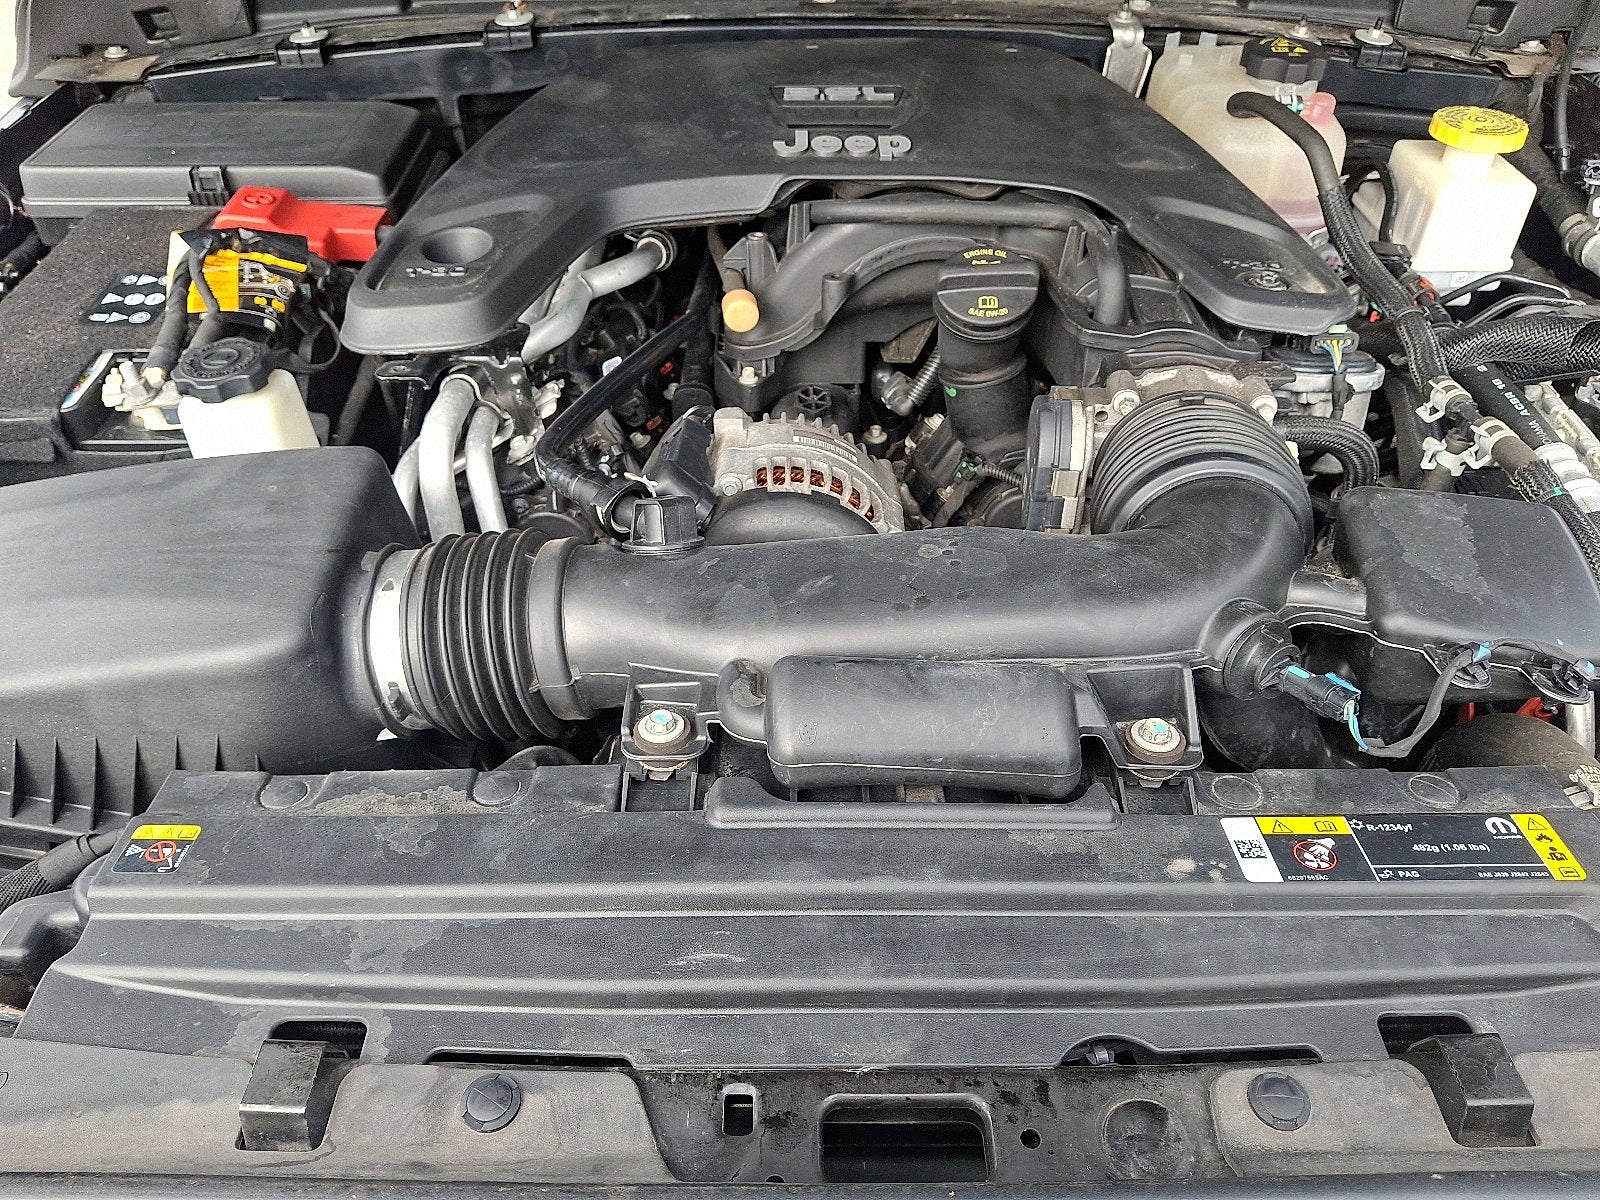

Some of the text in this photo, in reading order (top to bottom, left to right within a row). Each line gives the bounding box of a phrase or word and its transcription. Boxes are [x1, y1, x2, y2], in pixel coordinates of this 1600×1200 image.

[772, 129, 912, 161] Jeep
[963, 248, 1008, 259] ENGINE OIL
[967, 307, 985, 317] SAE
[1365, 823, 1413, 833] R-1234yf
[1398, 870, 1420, 879] PAG
